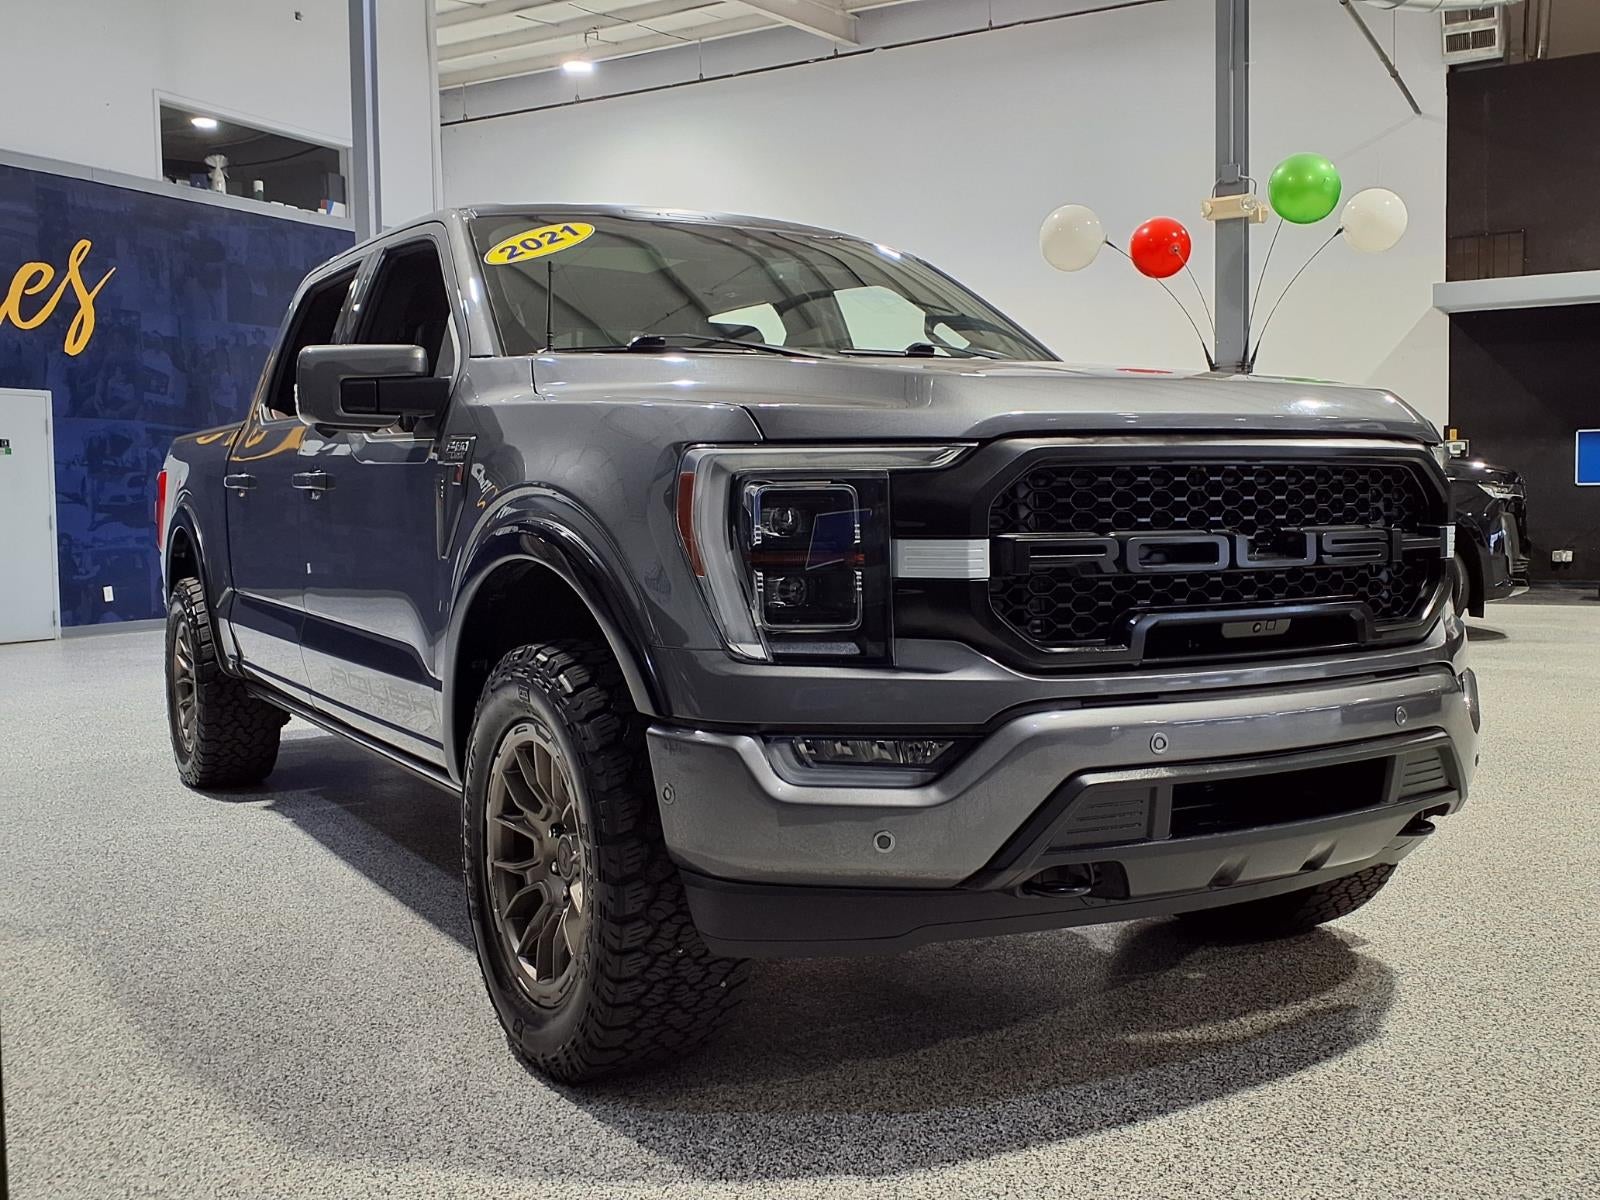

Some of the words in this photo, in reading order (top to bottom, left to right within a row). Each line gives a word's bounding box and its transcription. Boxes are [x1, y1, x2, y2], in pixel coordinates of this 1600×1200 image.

[498, 225, 579, 260] 2021
[0, 239, 116, 356] es
[1015, 528, 1444, 575] ROUSH
